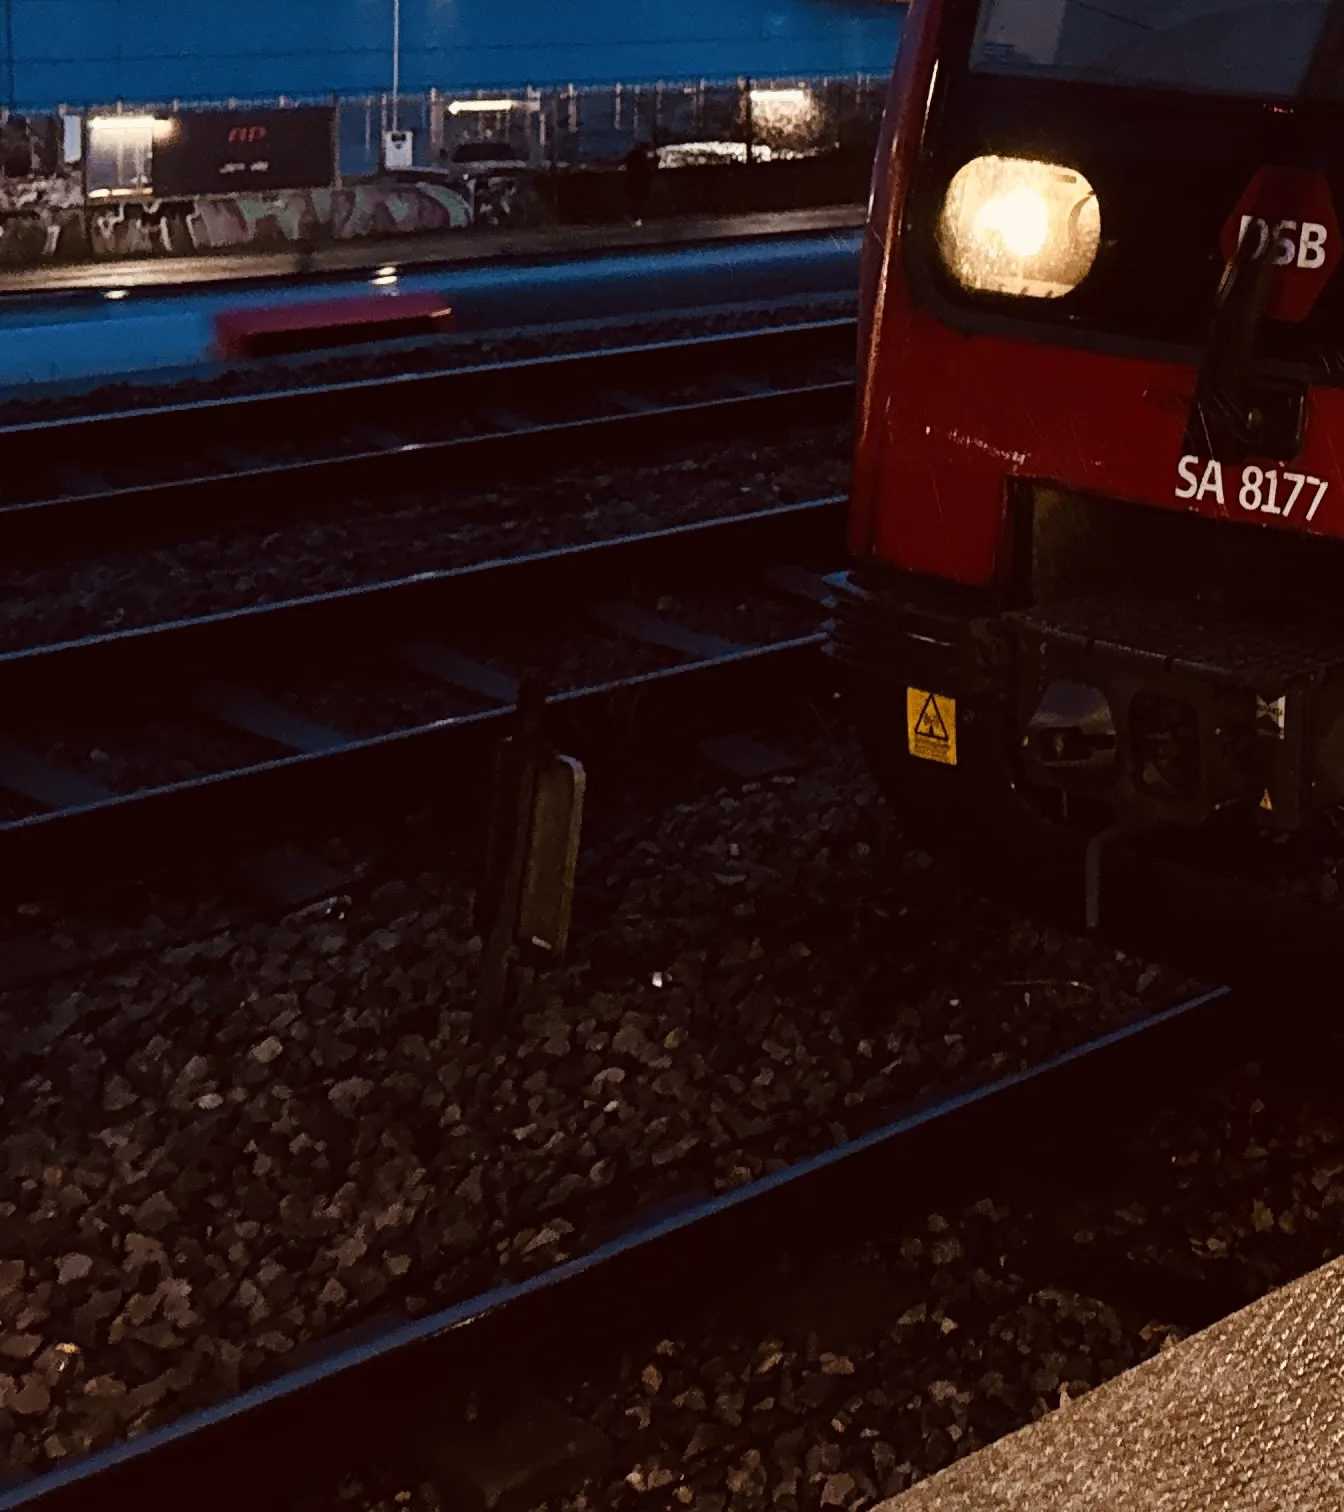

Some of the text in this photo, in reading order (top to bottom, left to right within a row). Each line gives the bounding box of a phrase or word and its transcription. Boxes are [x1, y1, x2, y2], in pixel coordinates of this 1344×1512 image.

[1237, 215, 1328, 269] DSB
[1175, 455, 1329, 522] SA 8177
